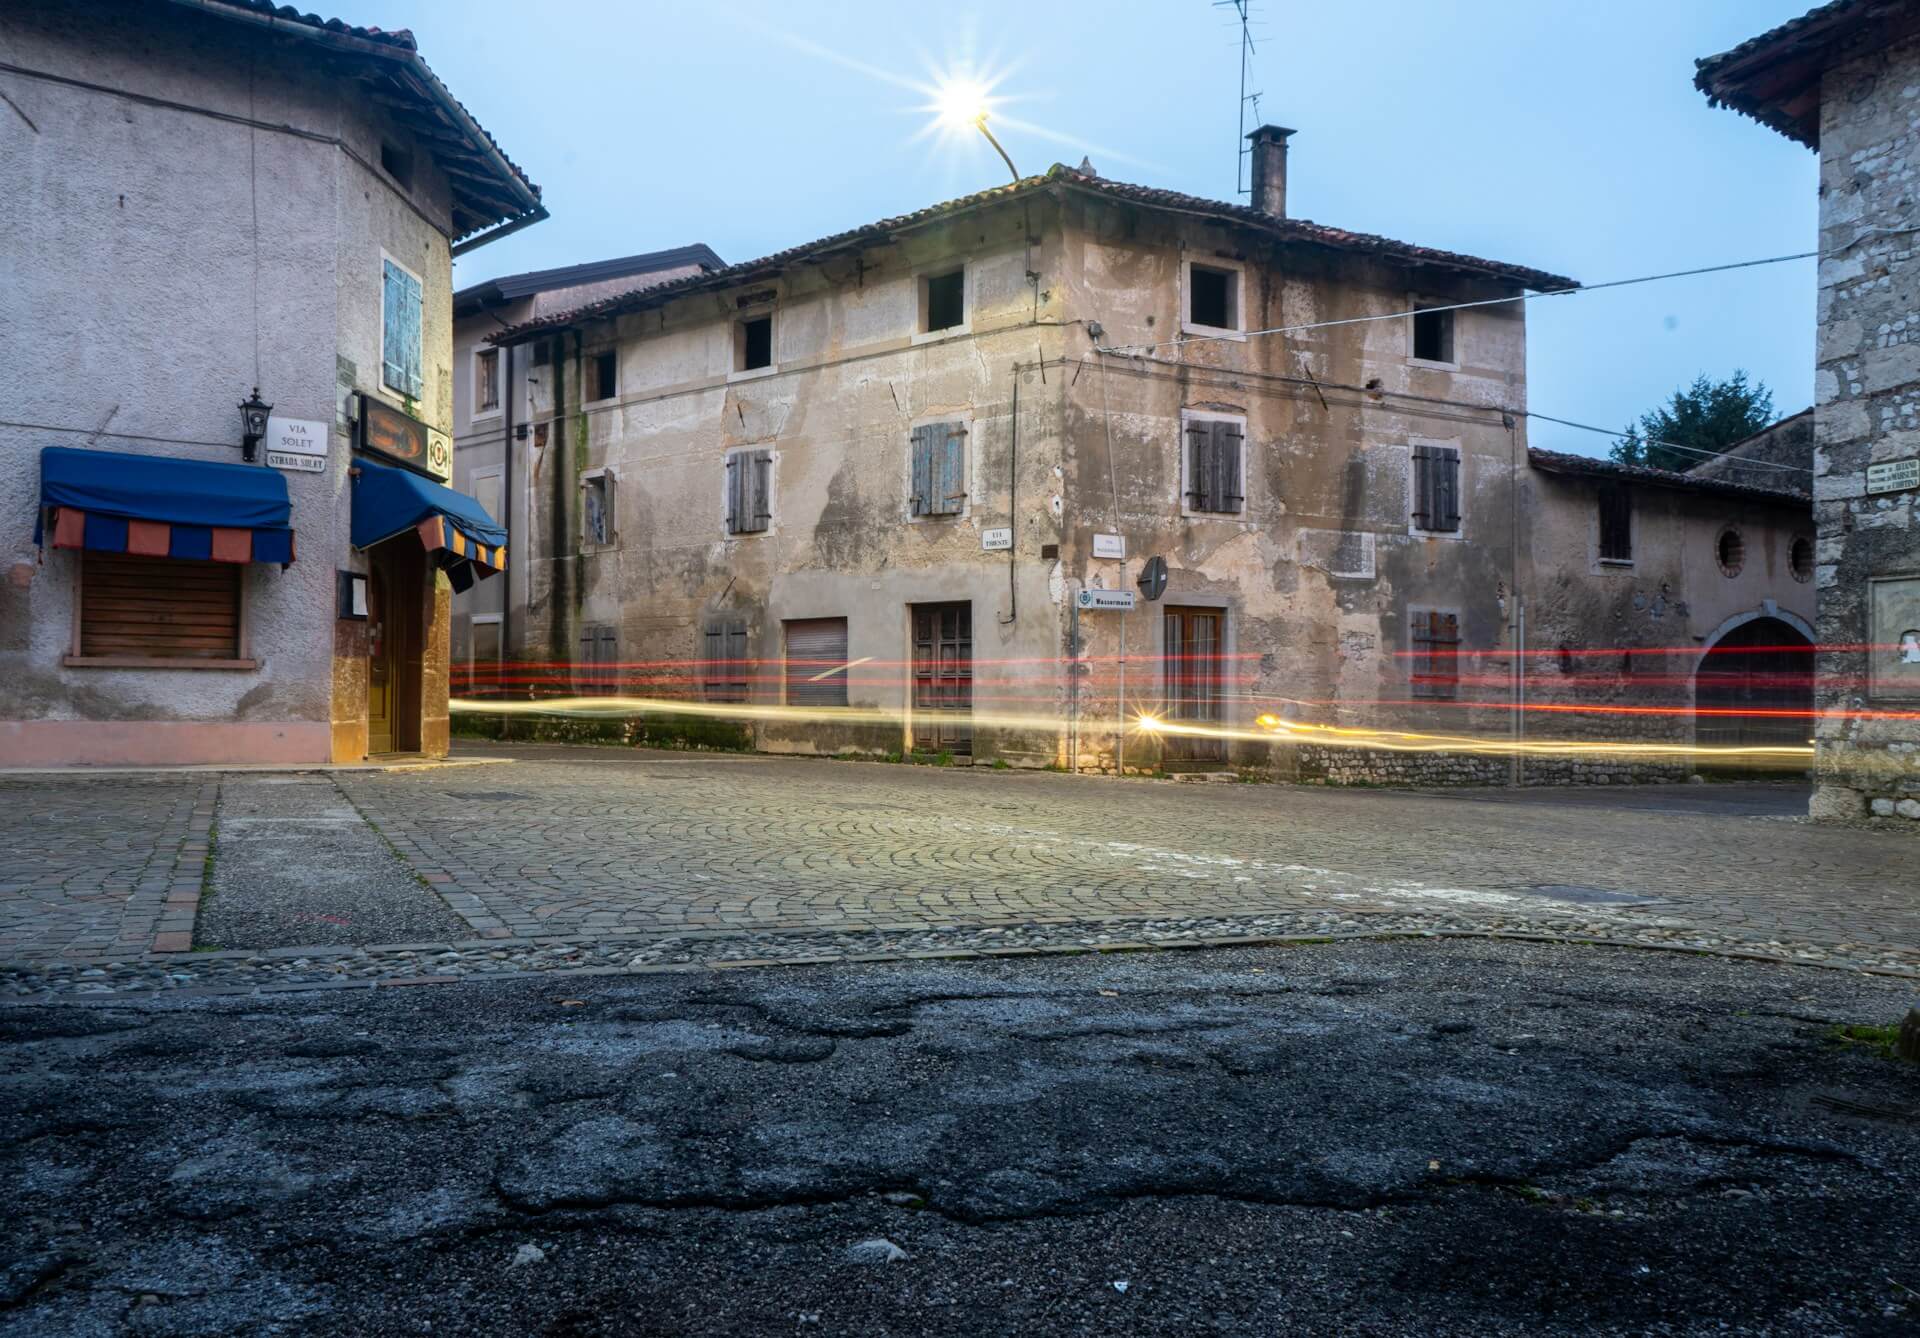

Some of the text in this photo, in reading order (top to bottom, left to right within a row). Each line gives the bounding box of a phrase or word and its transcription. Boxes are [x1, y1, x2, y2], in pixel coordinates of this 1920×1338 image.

[289, 424, 306, 434] VIA
[281, 437, 313, 448] SOLET
[270, 455, 298, 466] STRADA
[1096, 598, 1131, 606] Wassermann
